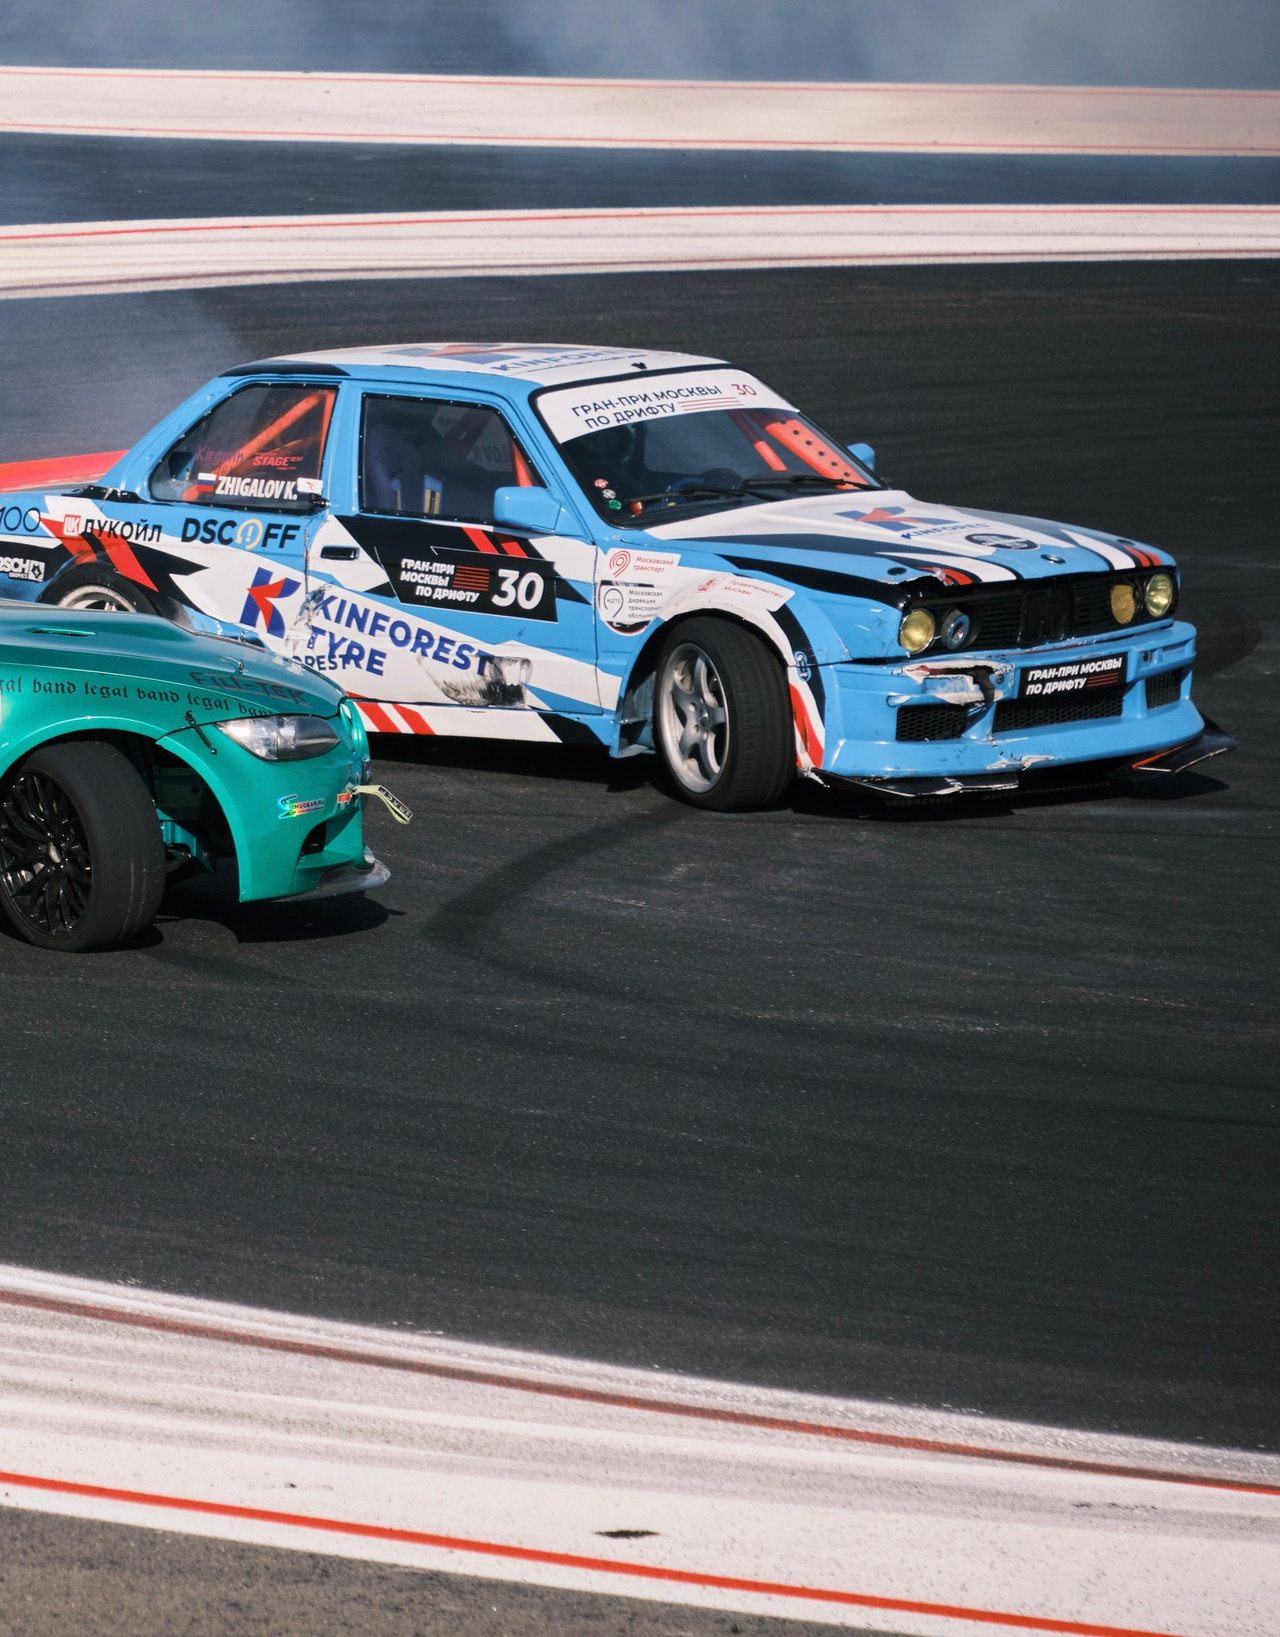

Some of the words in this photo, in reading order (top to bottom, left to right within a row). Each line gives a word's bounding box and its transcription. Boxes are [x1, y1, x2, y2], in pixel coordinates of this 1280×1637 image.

[731, 384, 758, 396] 30
[571, 393, 649, 417] ГРАН-ПРИ
[652, 385, 723, 401] МОСКВЫ
[584, 415, 611, 429] ПО
[616, 402, 677, 425] ДРИФТУ
[253, 456, 290, 466] STAGE
[215, 476, 286, 500] ZHIGALOV
[283, 480, 298, 500] K.
[84, 519, 163, 543] ЛУКОЙЛ
[401, 558, 455, 575] ГРАН-ПРИ
[633, 564, 665, 573] транспорт
[635, 556, 674, 565] Московский
[400, 571, 450, 587] МОСКВЫ
[415, 586, 432, 597] ПО
[434, 588, 480, 603] ДРИФТУ
[491, 569, 545, 610] 30
[722, 585, 753, 596] Москвы
[729, 580, 784, 599] Правительство
[316, 591, 496, 677] KINFOREST
[306, 626, 388, 677] TYRE
[1028, 666, 1078, 681] ГРАН-ПРИ
[1080, 657, 1123, 674] МОСКВЫ
[189, 671, 307, 704] FILI-TEK
[1026, 683, 1043, 695] ПО
[1043, 677, 1087, 694] ДРИФТУ
